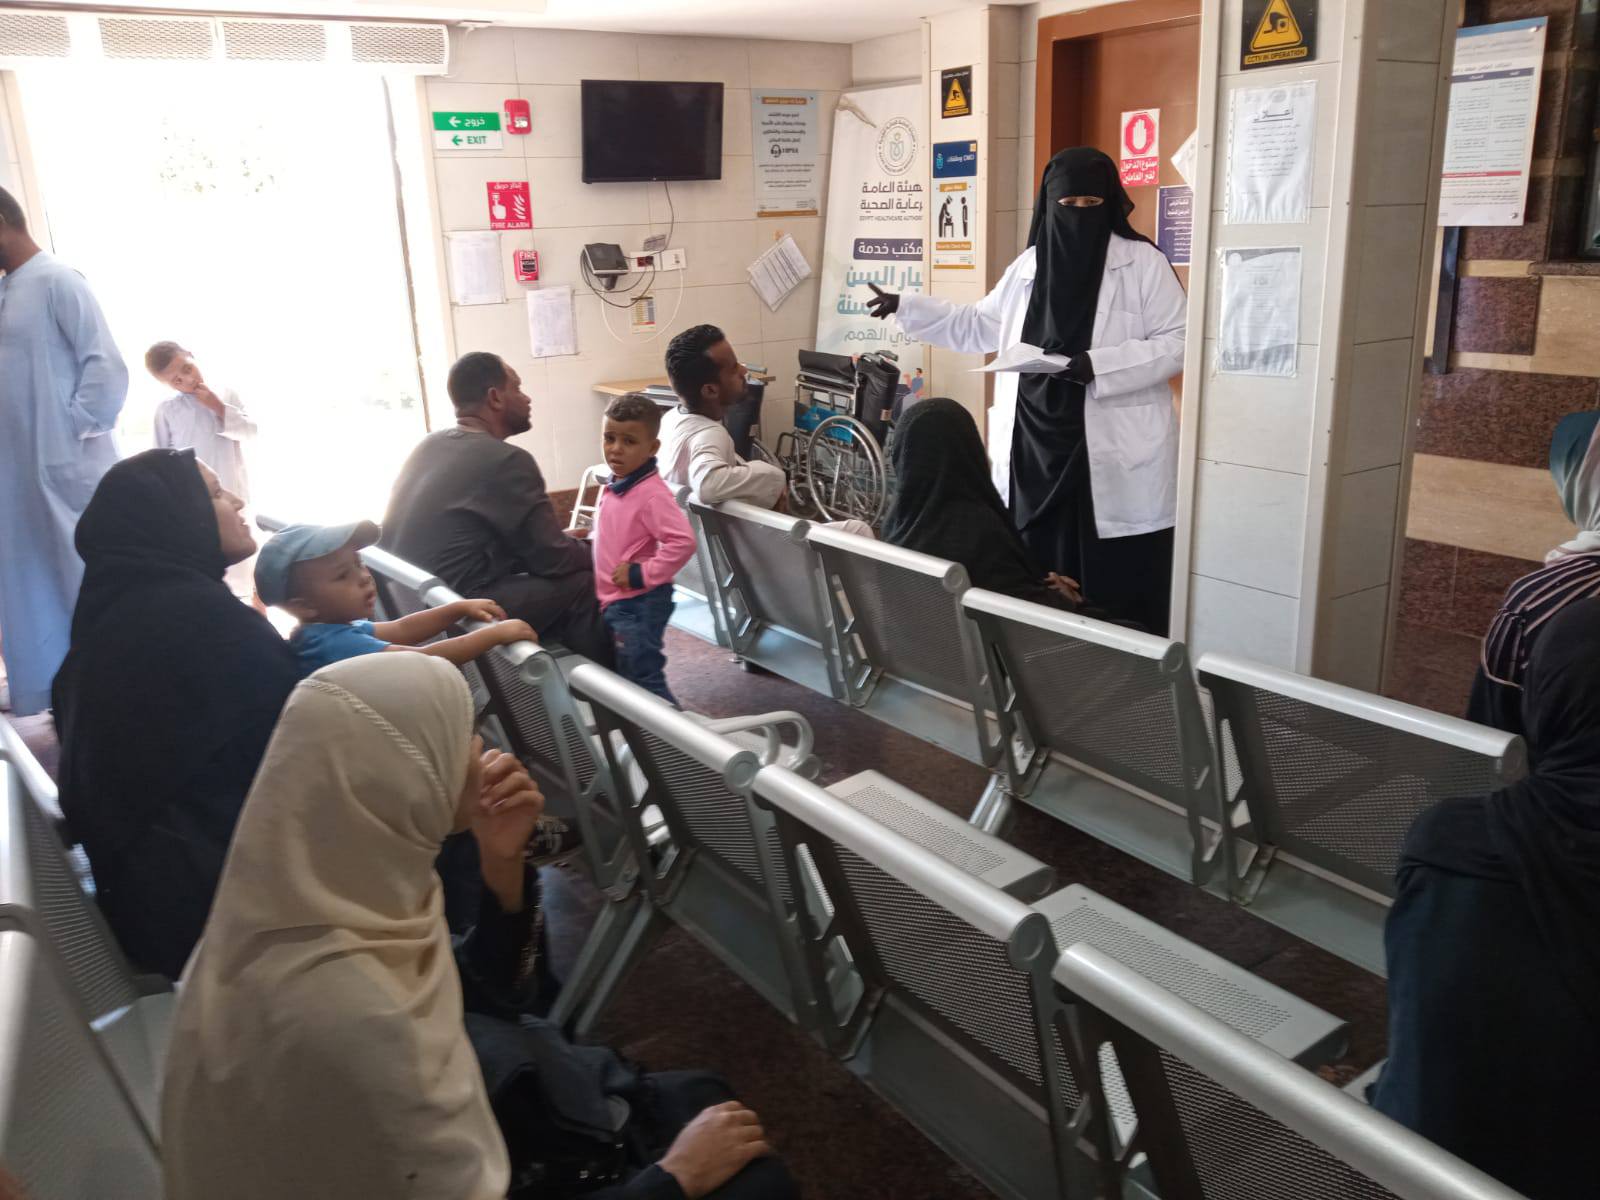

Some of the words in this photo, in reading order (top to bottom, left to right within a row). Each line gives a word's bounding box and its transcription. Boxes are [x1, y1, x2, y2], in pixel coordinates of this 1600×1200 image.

[1271, 49, 1306, 60] OPERATION
[464, 116, 486, 128] خروج
[466, 135, 487, 145] EXIT
[1120, 161, 1142, 172] الدخول
[1142, 159, 1158, 171] ممنوع
[1122, 172, 1144, 185] العاملين
[1144, 171, 1155, 184] لغير
[862, 181, 895, 194] العامة
[896, 180, 923, 196] هيئة
[860, 198, 894, 214] الصحية
[895, 197, 923, 214] رعاية
[858, 241, 889, 254] خدمة
[891, 242, 923, 258] مكتب
[519, 250, 537, 259] FIRE
[846, 265, 895, 288] السن
[897, 266, 923, 292] بار
[844, 328, 887, 342] الهمم
